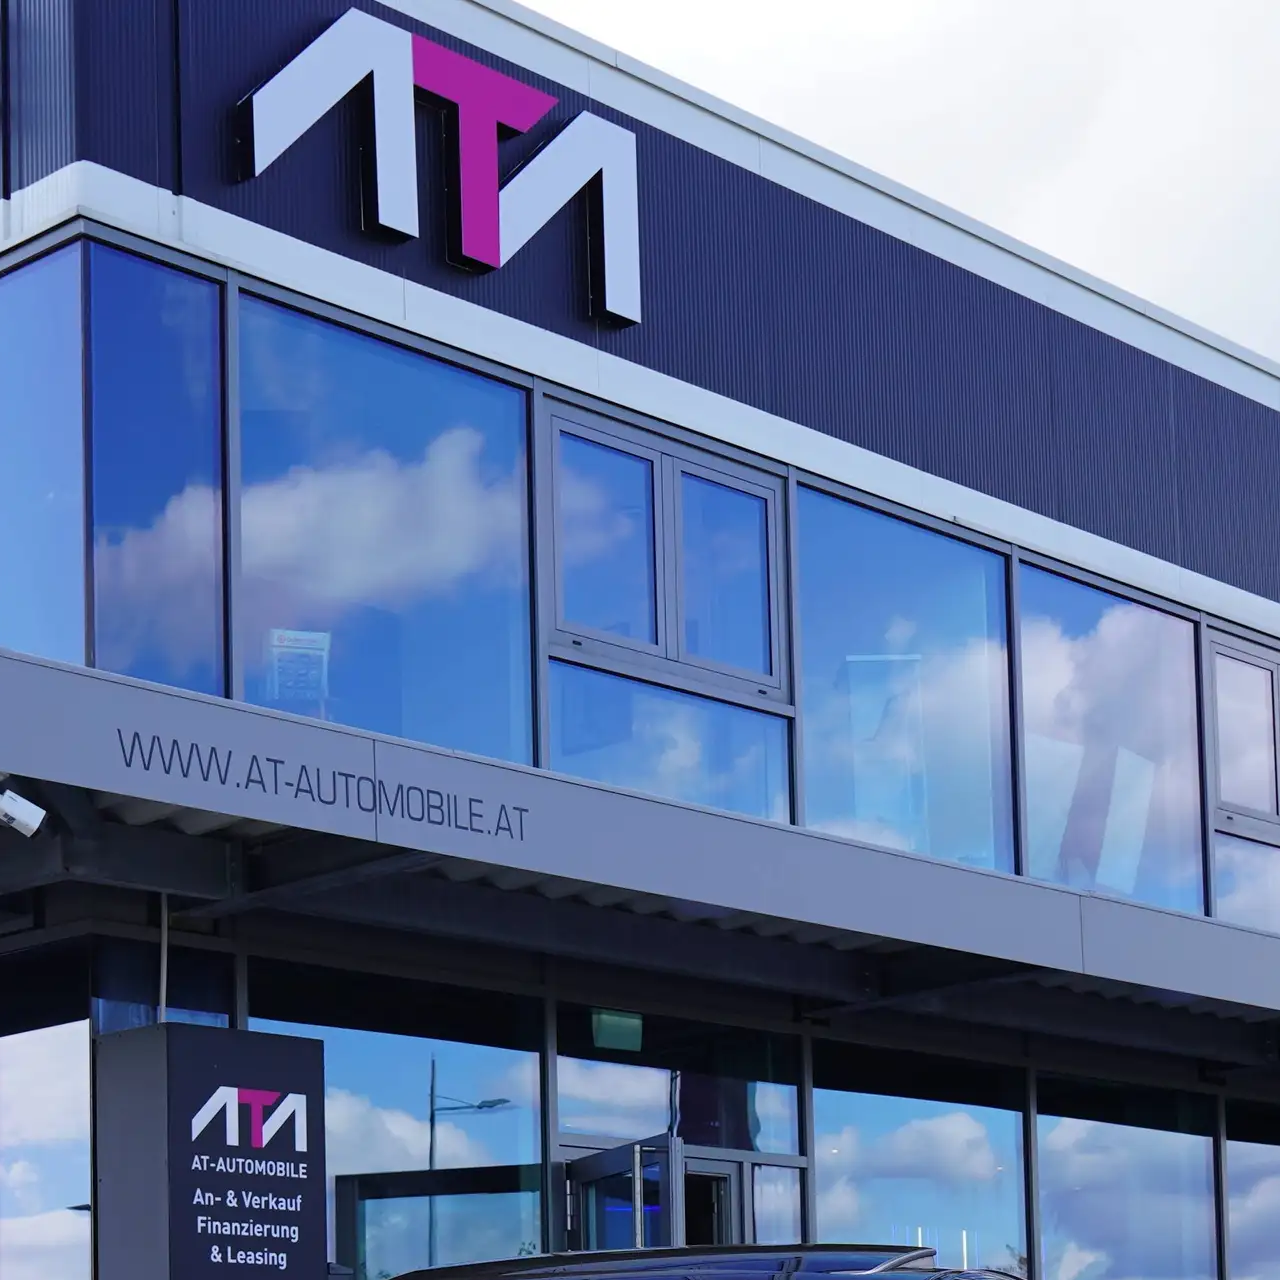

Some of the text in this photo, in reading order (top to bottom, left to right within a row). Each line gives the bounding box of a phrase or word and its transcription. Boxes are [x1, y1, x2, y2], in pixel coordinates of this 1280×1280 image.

[117, 728, 530, 842] WWW.AT-AUTOMOBILE.AT
[191, 1154, 308, 1180] AT-AUTOMOBILE
[192, 1187, 302, 1212] An- & Verkauf
[196, 1215, 299, 1243] Finanzierung
[210, 1245, 287, 1270] & Leasing
